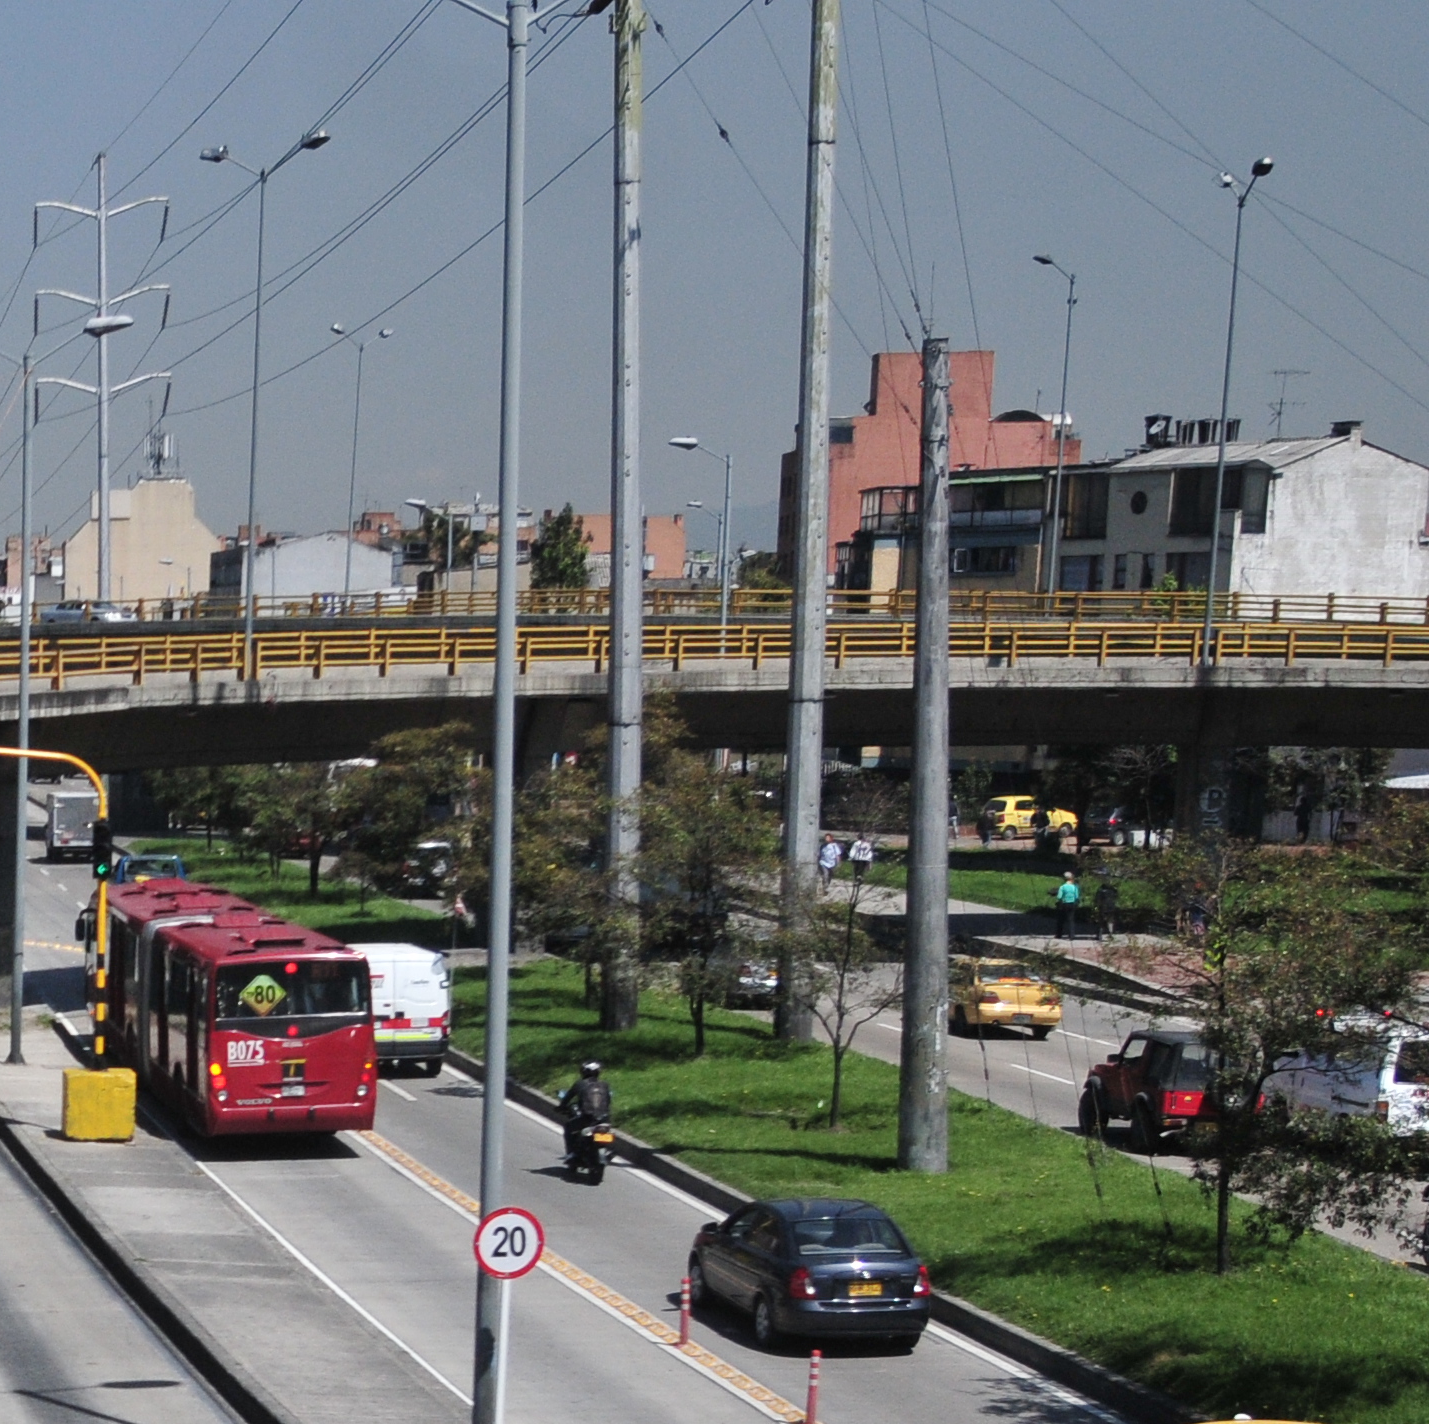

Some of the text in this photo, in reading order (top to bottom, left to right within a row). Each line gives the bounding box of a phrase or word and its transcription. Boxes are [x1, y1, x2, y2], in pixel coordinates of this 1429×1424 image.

[254, 984, 276, 1005] 80
[227, 1040, 265, 1060] B075
[236, 1098, 273, 1106] VOLVO
[491, 1226, 527, 1258] 20
